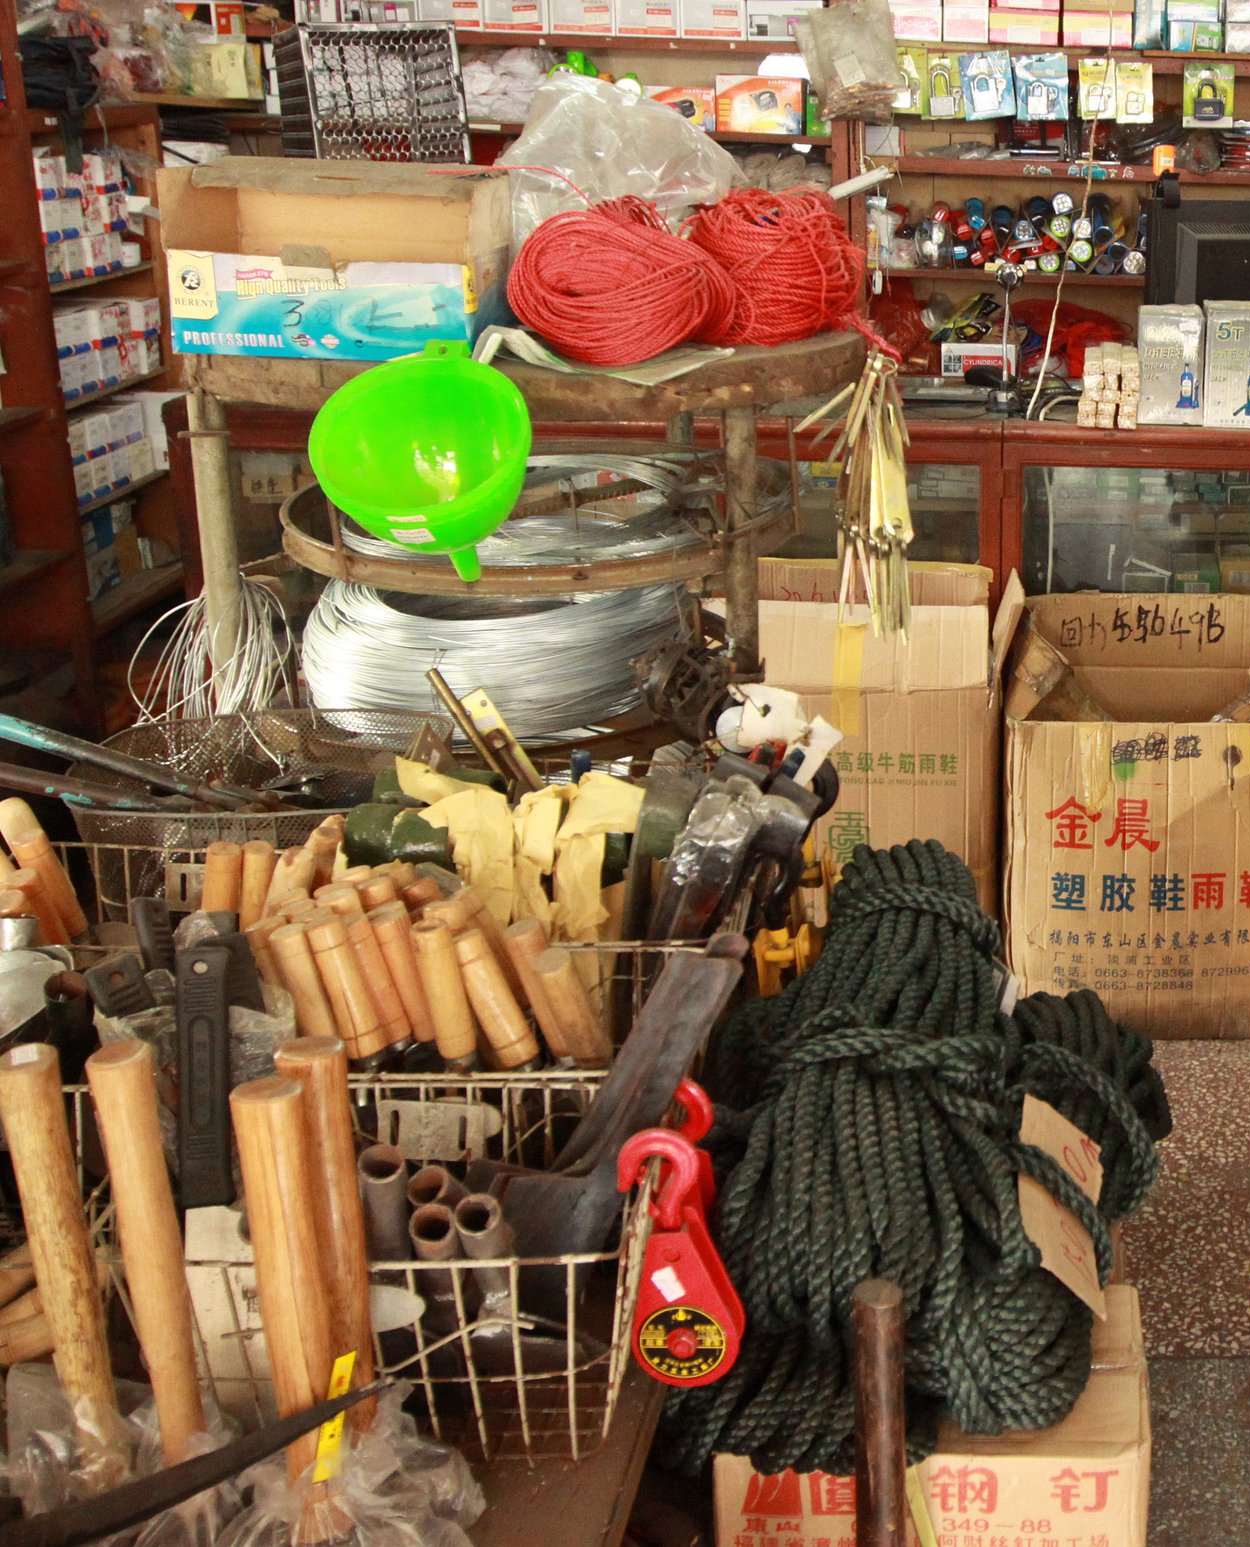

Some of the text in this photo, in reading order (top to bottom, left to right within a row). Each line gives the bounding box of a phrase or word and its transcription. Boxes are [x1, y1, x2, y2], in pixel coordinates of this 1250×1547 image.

[236, 279, 264, 299] High
[174, 297, 214, 308] BERENT
[183, 331, 285, 349] PROFESSIONAL
[1216, 321, 1244, 341] 5T
[1045, 795, 1160, 852] 金晨
[1095, 967, 1194, 980] 0663-8738368
[1094, 980, 1194, 992] 0663-8728848
